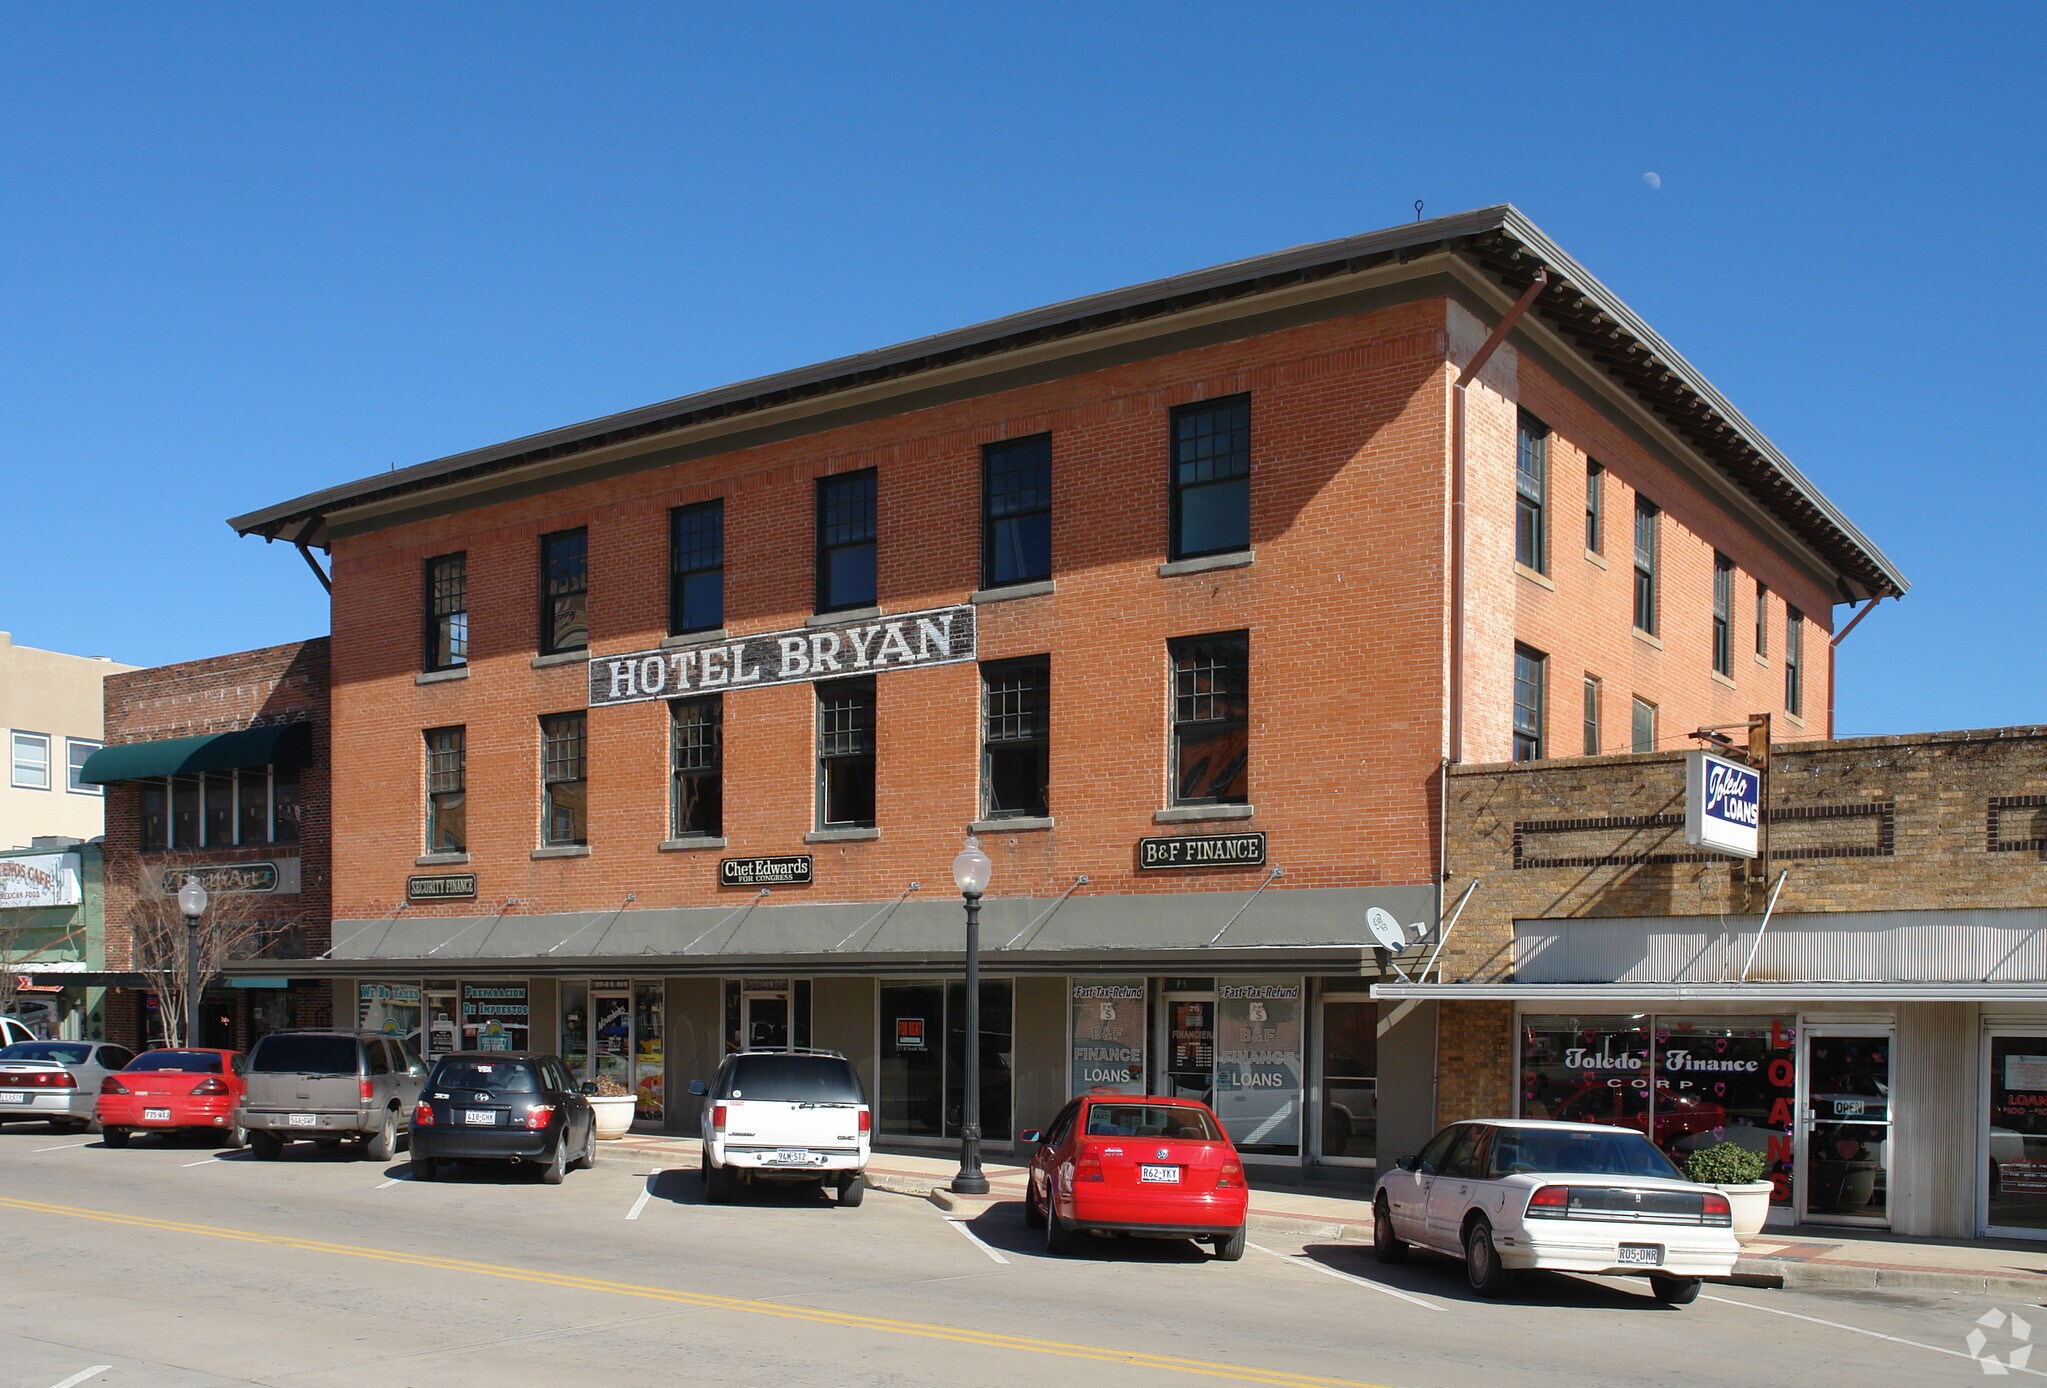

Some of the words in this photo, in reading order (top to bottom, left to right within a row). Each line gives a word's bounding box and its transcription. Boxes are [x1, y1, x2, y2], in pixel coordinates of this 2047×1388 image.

[608, 643, 760, 698] HOTEL
[777, 614, 954, 677] BRYAN
[1707, 766, 1748, 810] Toledo
[1724, 796, 1757, 825] LOANS
[1146, 842, 1180, 862] B&F
[1185, 839, 1258, 860] FINANCE
[725, 861, 753, 876] Chet
[755, 859, 808, 874] Edwards
[756, 873, 793, 881] CONGRESS
[411, 880, 445, 894] SECURITY
[446, 878, 473, 893] FINANCE
[465, 986, 525, 998] PREPARACION
[463, 1002, 476, 1014] DE
[480, 1003, 528, 1015] IMPUESTOS
[1092, 1027, 1123, 1040] B&F
[1240, 1028, 1276, 1042] B&F
[1074, 1048, 1140, 1062] FINANCE
[1222, 1051, 1295, 1065] FINANCE
[1565, 1048, 1641, 1070] Toledo
[1666, 1050, 1759, 1073] Finance
[1084, 1069, 1130, 1083] LOANS
[1232, 1073, 1283, 1087] LOANS
[1767, 1020, 1796, 1201] LOANS
[1836, 1102, 1863, 1113] OPEN
